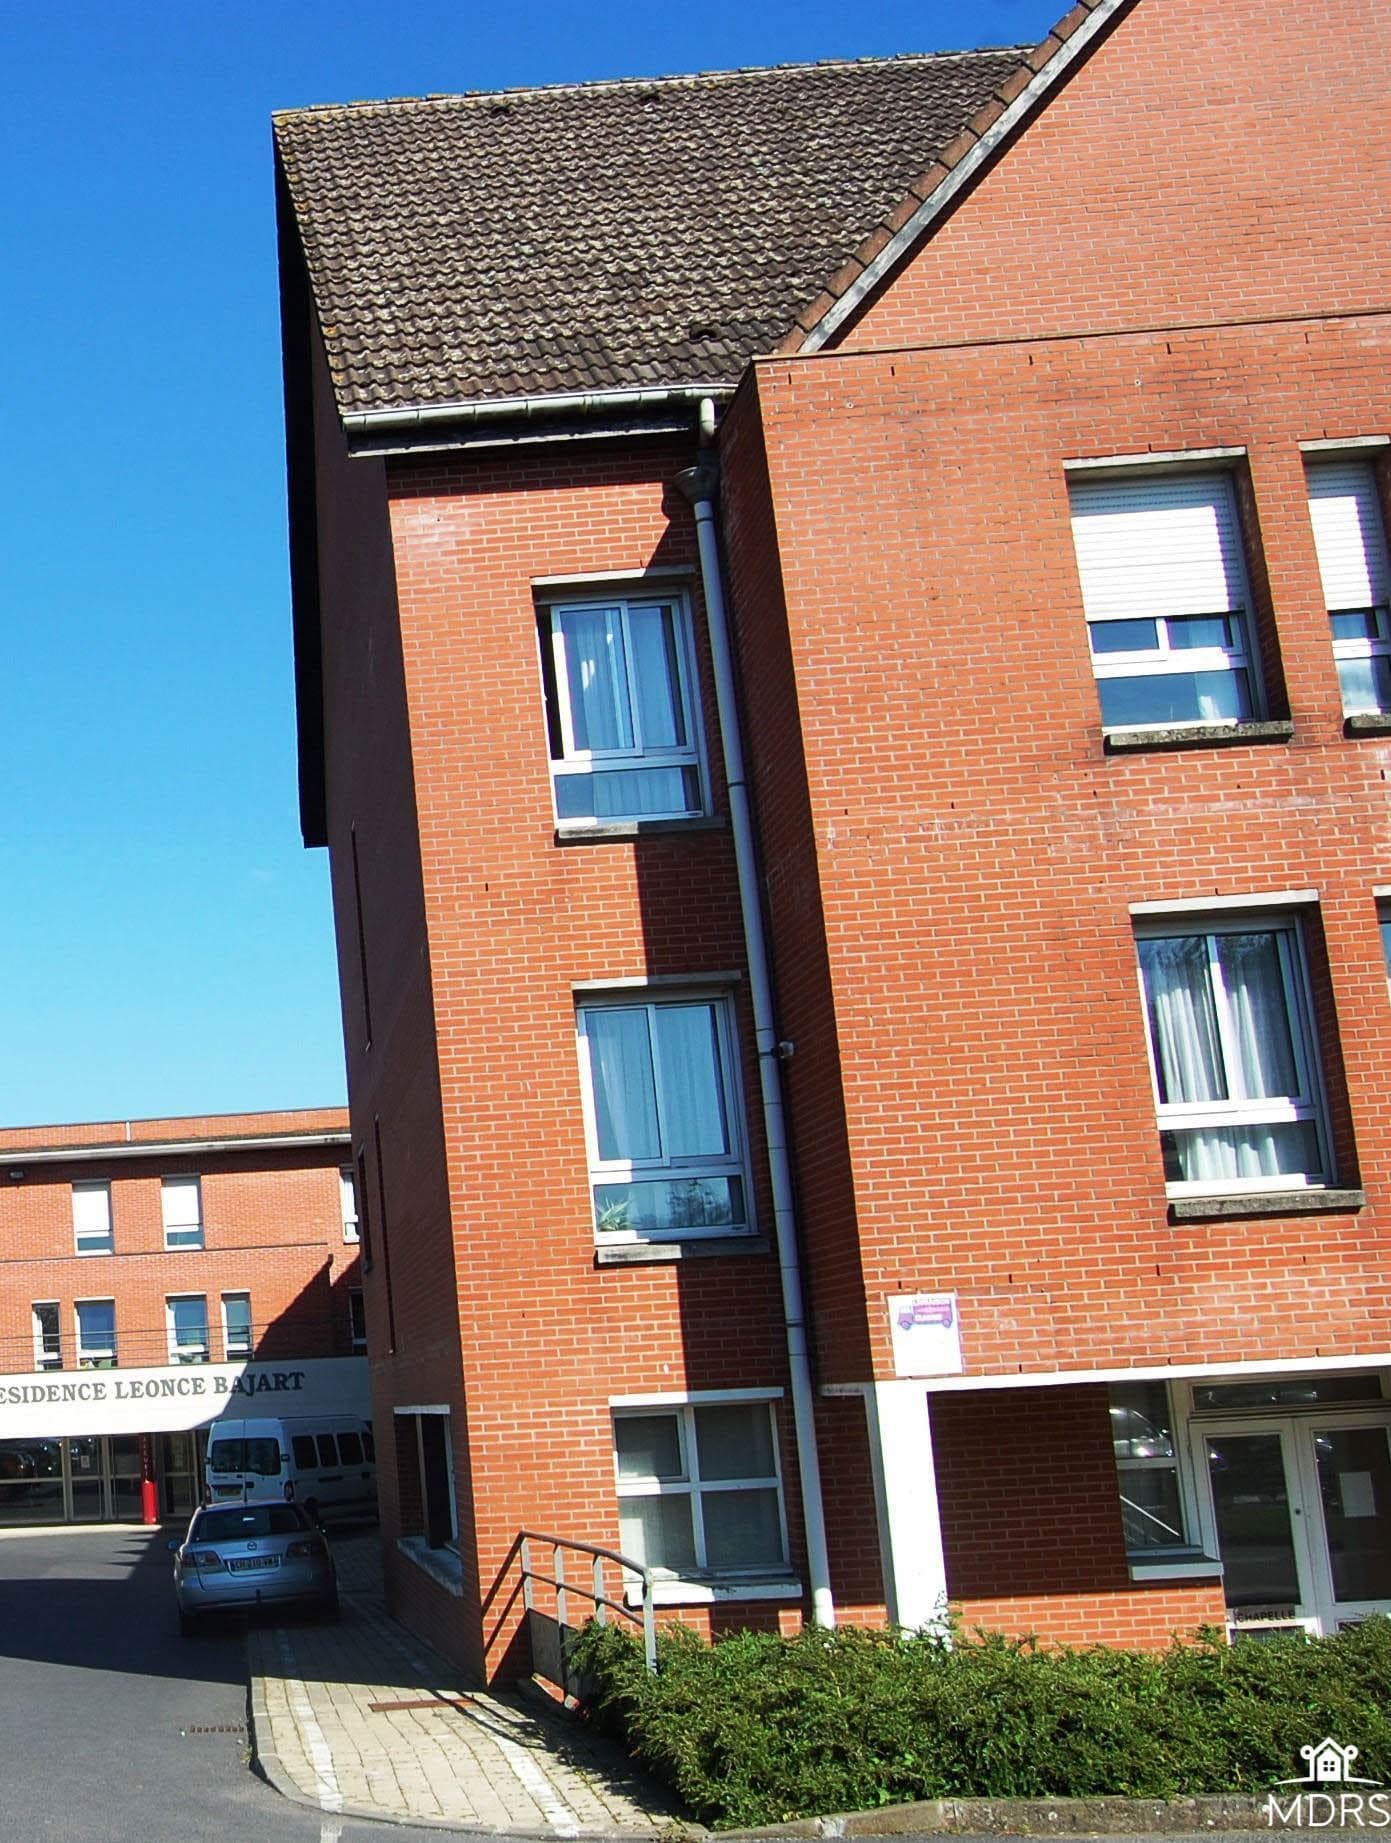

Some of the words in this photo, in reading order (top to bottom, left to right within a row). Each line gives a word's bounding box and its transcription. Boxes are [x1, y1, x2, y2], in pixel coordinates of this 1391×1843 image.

[114, 1377, 206, 1399] LEONCE
[213, 1372, 305, 1396] BAJART
[1236, 1608, 1296, 1623] CHAPELLE
